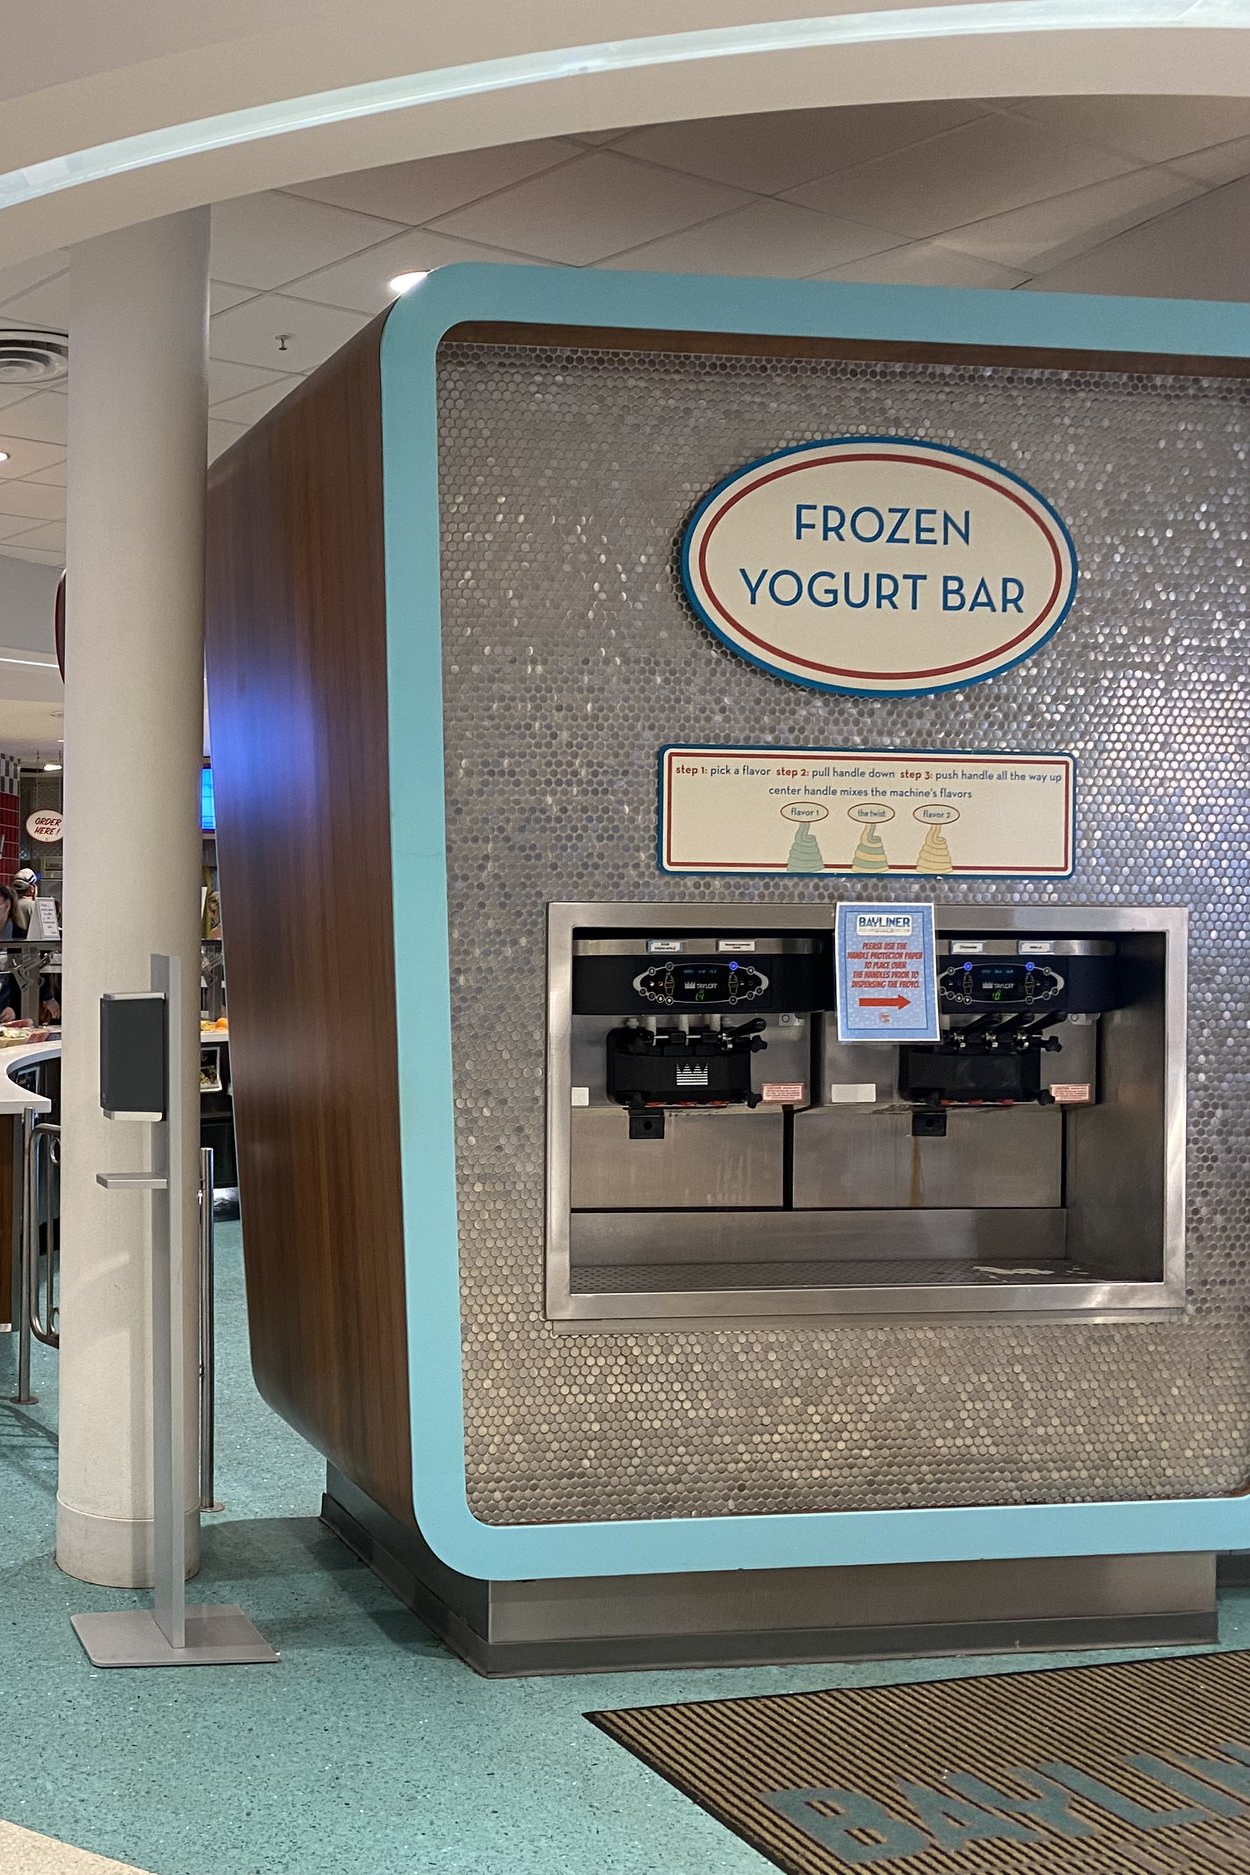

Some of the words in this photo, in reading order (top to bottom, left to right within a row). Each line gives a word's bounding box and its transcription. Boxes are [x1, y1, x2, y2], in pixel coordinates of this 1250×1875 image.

[795, 504, 970, 546] FROZEN
[739, 568, 928, 610] YOGURT
[942, 575, 1025, 613] BAR
[675, 765, 698, 776] step
[701, 766, 708, 775] 1:
[710, 765, 731, 777] pick
[734, 767, 740, 775] a
[742, 765, 771, 776] flavor
[776, 767, 798, 778] step
[800, 768, 810, 777] 2:
[812, 767, 830, 779] pull
[832, 767, 864, 778] handle
[868, 768, 895, 778] down
[900, 770, 922, 781] step
[924, 772, 933, 780] 3:
[935, 770, 958, 783] push
[961, 770, 994, 780] handle
[996, 771, 1008, 780] all
[1010, 771, 1026, 781] the
[1028, 774, 1047, 783] way
[1049, 774, 1062, 783] up
[768, 786, 801, 796] center
[804, 786, 837, 796] handle
[840, 787, 868, 796] mixes
[871, 788, 887, 797] the
[889, 788, 937, 798] machine's
[940, 788, 972, 799] flavors
[791, 808, 814, 816] flavor
[857, 808, 868, 817] the
[870, 809, 886, 817] twist
[923, 810, 945, 818] flavor
[946, 811, 951, 819] 2
[35, 817, 62, 827] ORDER
[859, 917, 911, 927] BAYLINER
[870, 951, 903, 959] PROTECTOR
[904, 951, 923, 959] PAPER
[864, 961, 872, 969] TO
[873, 961, 890, 969] PLACE
[891, 961, 907, 969] OVER
[851, 980, 886, 988] DISPENSING
[887, 980, 898, 988] THE
